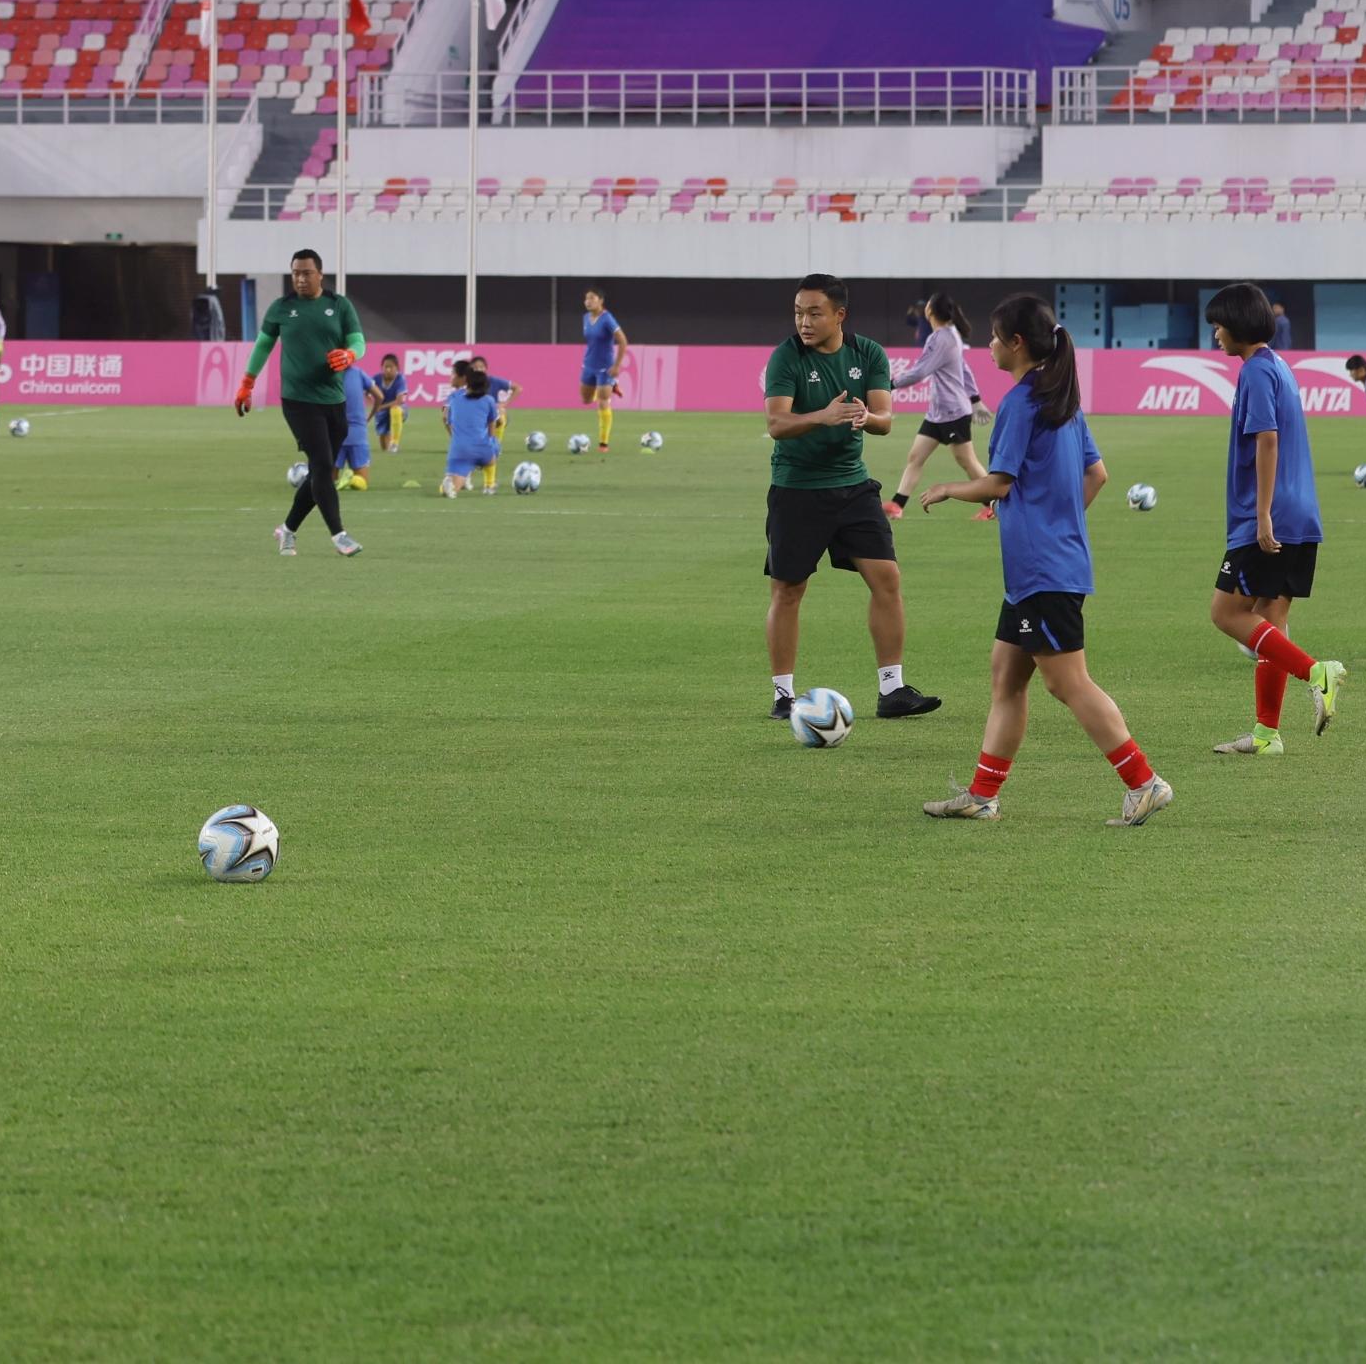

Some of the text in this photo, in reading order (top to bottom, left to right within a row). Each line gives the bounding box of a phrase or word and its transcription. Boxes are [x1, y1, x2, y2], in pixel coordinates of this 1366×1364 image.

[19, 353, 123, 378] 中国联通
[18, 380, 122, 394] China unicom
[1136, 385, 1201, 411] ANTA
